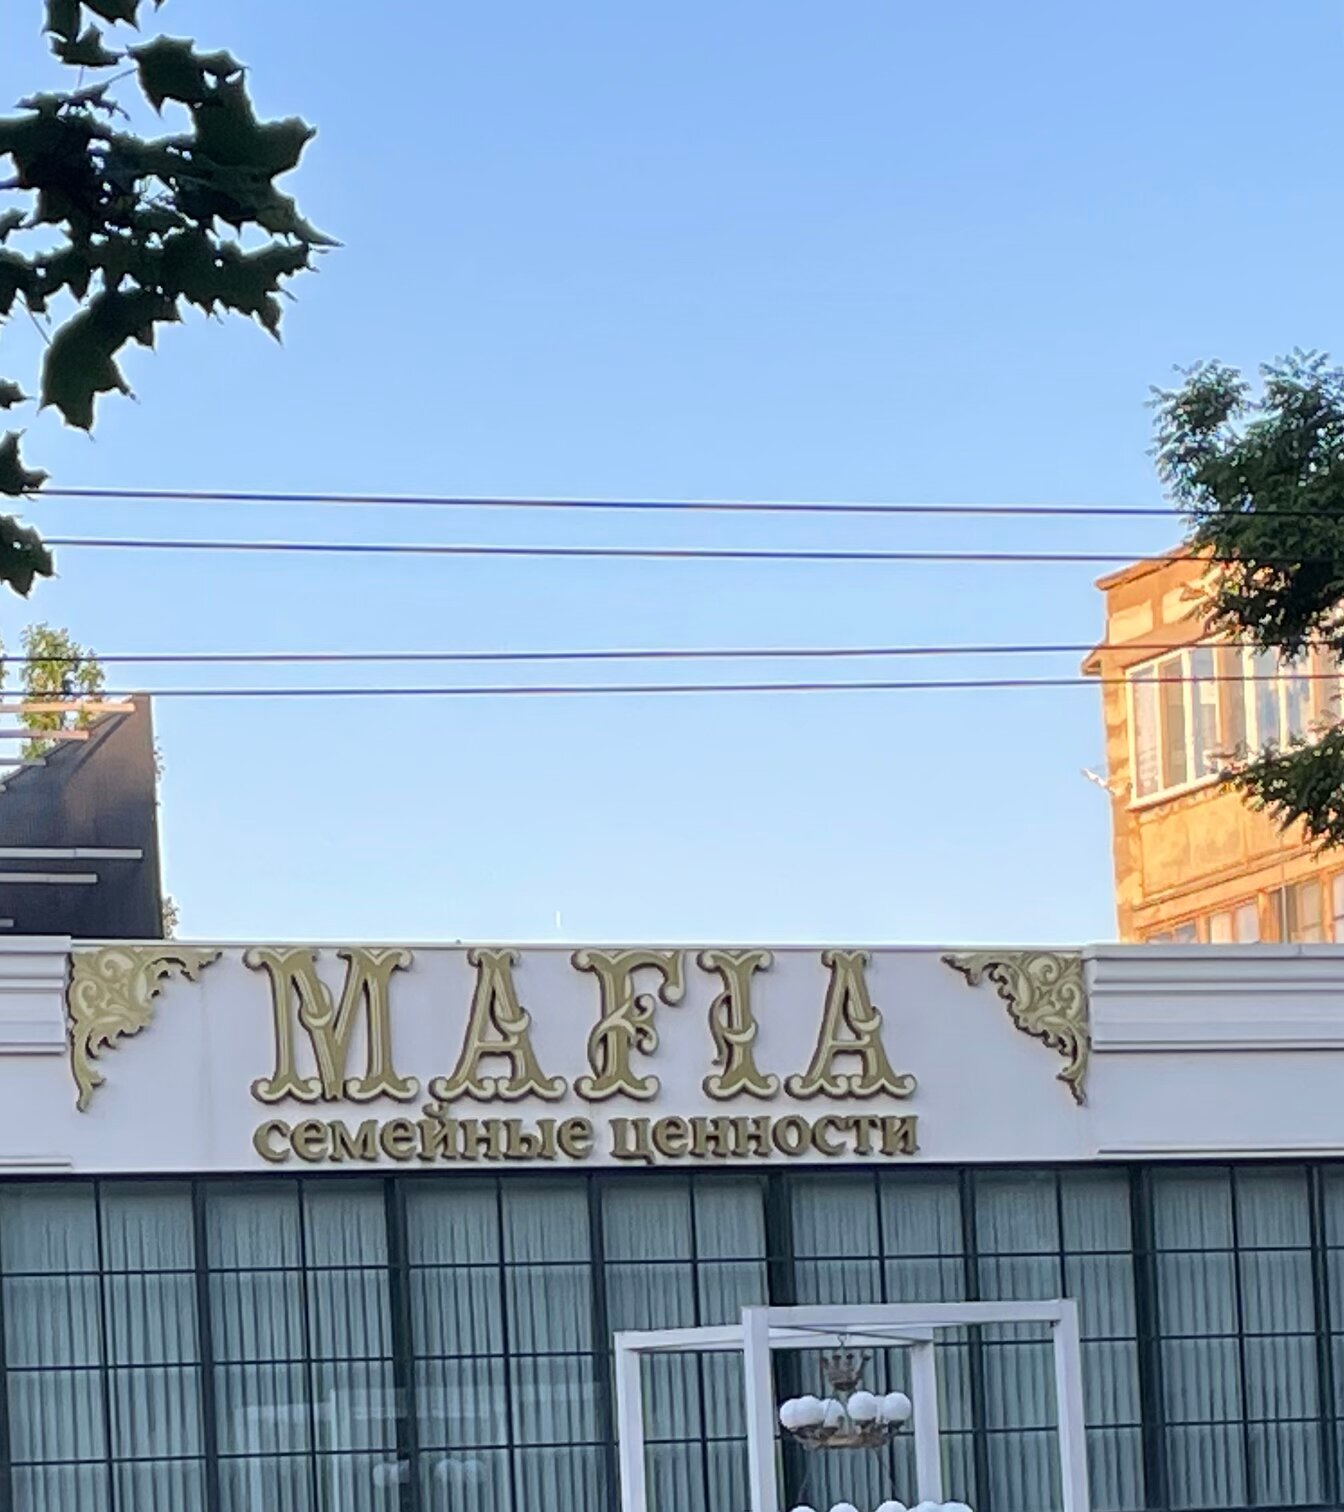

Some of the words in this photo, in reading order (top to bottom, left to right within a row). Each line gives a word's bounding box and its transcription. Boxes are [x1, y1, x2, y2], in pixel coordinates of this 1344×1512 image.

[243, 948, 918, 1104] MAFIA
[252, 1104, 595, 1164] семейные
[610, 1112, 920, 1164] ценности
